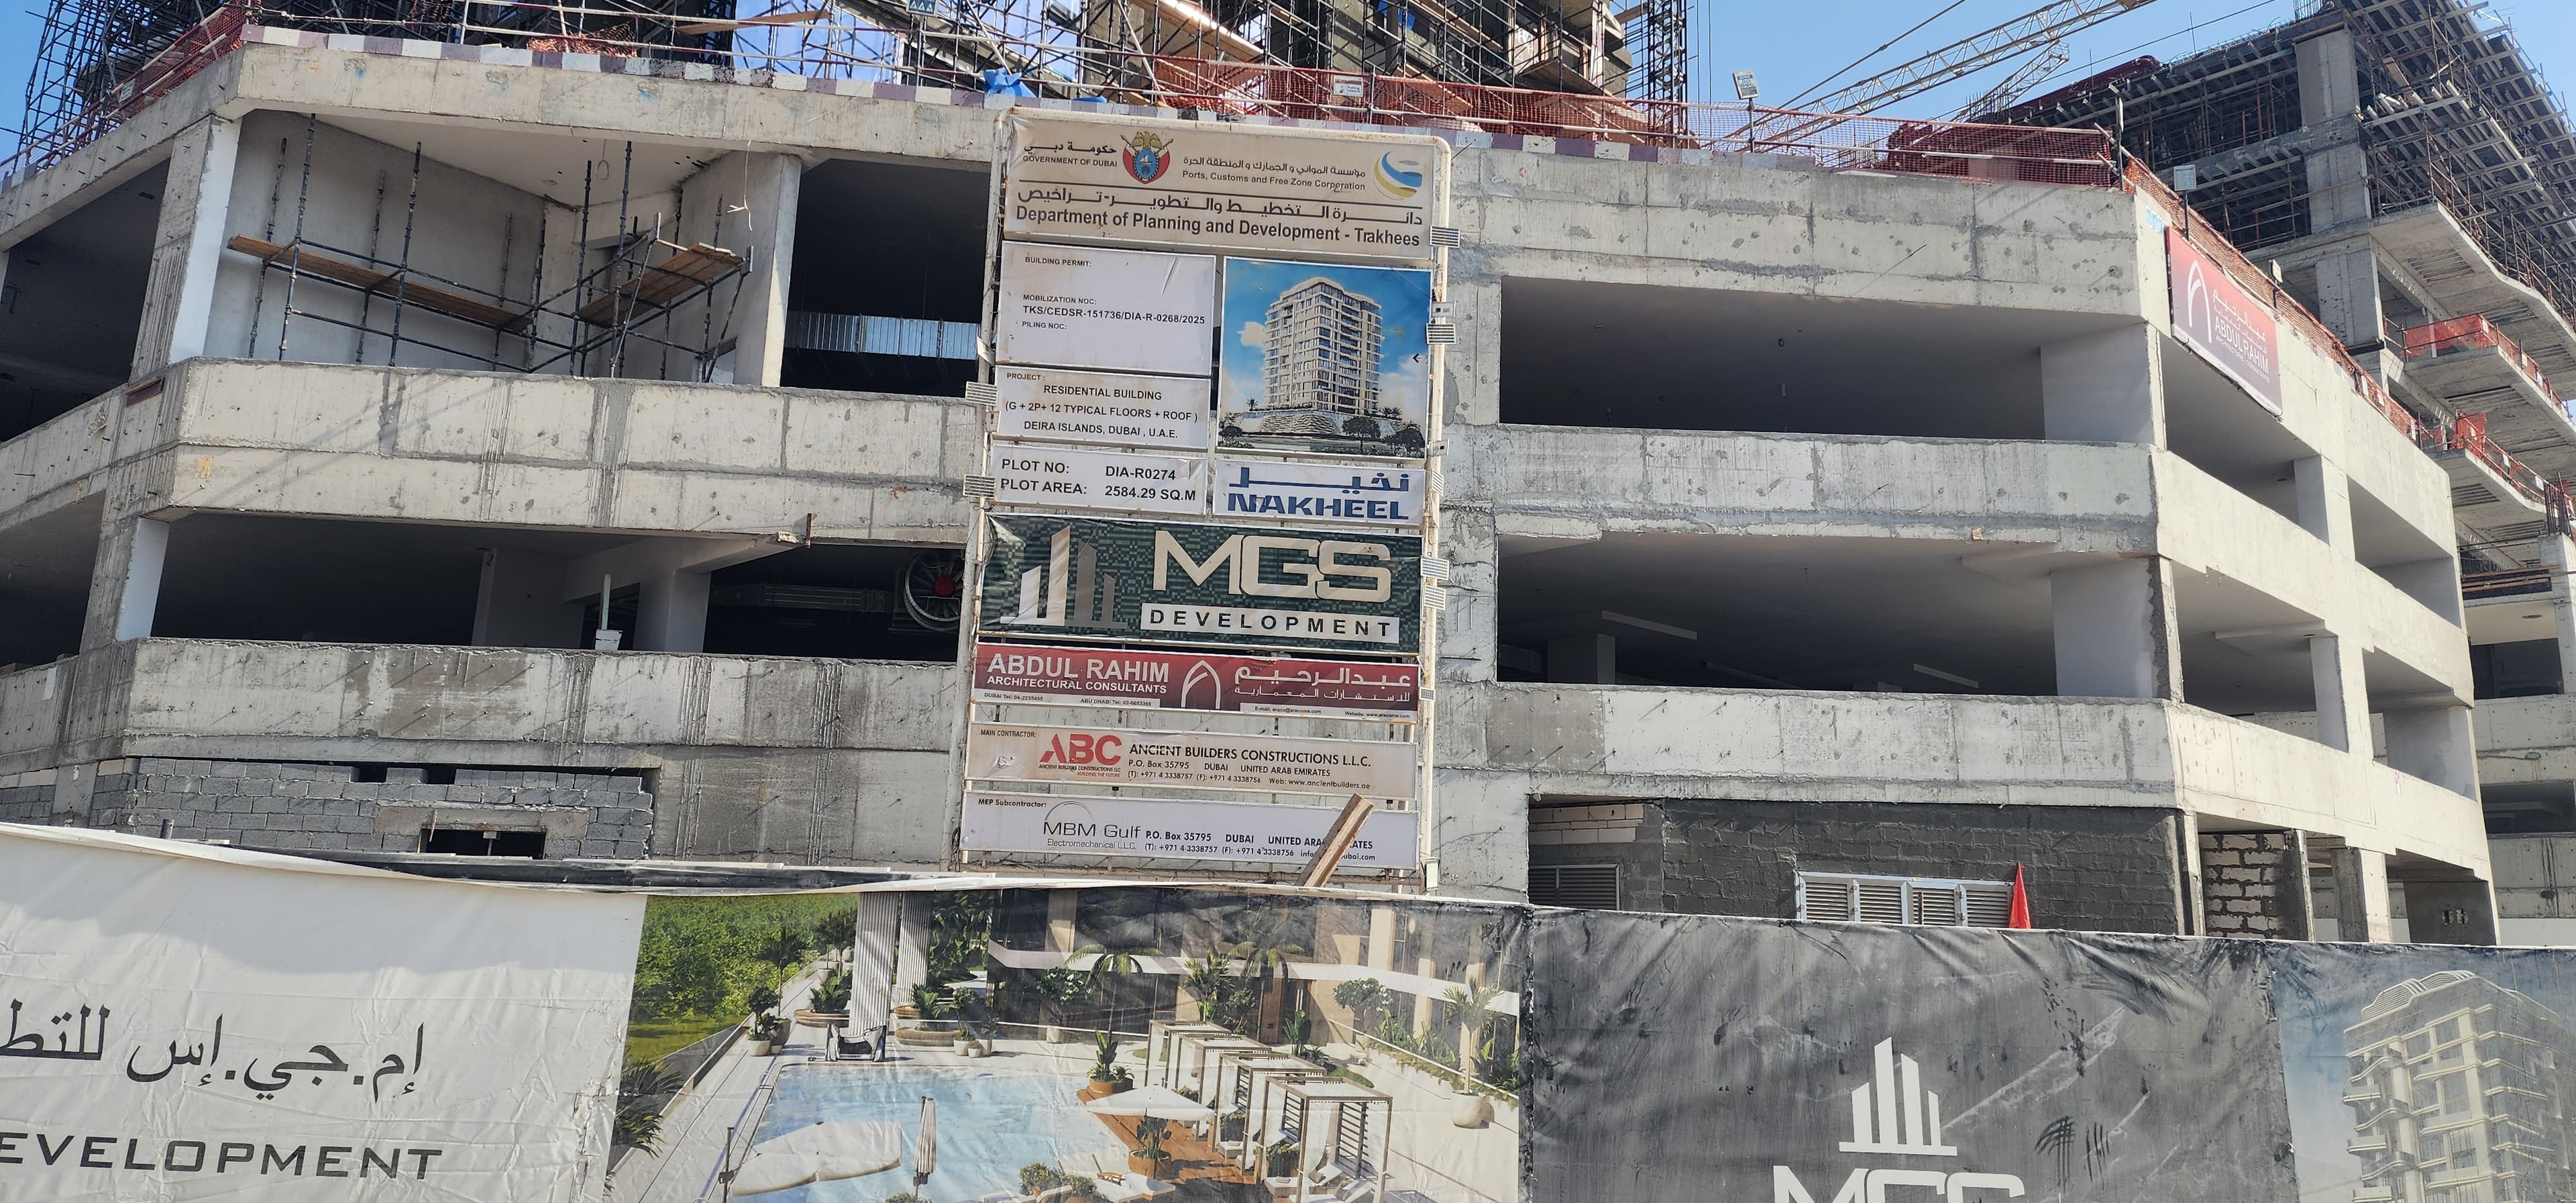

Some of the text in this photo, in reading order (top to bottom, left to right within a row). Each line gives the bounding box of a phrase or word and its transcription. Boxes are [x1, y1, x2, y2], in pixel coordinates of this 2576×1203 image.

[1024, 141, 1117, 156] حكومة دبي
[1022, 155, 1118, 167] GOVERNMENT OF DUBAI
[1183, 156, 1205, 166] الحرة
[1206, 157, 1244, 168] المنطقة
[1252, 161, 1287, 172] الجمارك
[1330, 166, 1366, 178] مؤسسة
[1183, 170, 1366, 191] Ports, Customs and Free Zone Corporation
[1226, 199, 1330, 219] التخطيط
[1016, 205, 1108, 225] Department
[1112, 212, 1129, 227] of
[1132, 213, 1201, 235] Planning
[1205, 219, 1234, 234] and
[1239, 220, 1340, 242] Development
[1354, 227, 1420, 246] Trakhees
[1025, 256, 1092, 267] BUILDING PERMIT:
[1023, 294, 1097, 305] MOBILIZATION NOC:
[1022, 305, 1205, 325] TKS/CEDSR-151736/DIA-R-0268/2025
[1022, 321, 1067, 330] PILING NOC:
[2215, 315, 2243, 353] ABDUL
[2243, 339, 2269, 375] RAHIM
[1006, 372, 1041, 381] PROJECT
[1043, 384, 1162, 401] RESIDENTIAL BUILDING
[1005, 401, 1017, 411] (G
[1051, 404, 1061, 413] 12
[1064, 405, 1107, 416] TYPICAL
[1109, 407, 1151, 419] FLOORS
[1163, 411, 1192, 421] ROOF
[1024, 421, 1056, 431] DEIRA
[1058, 423, 1106, 435] ISLANDS,
[1108, 425, 1141, 436] DUBAI
[1148, 428, 1179, 439] U.A.E.
[1002, 458, 1070, 474] PLOT NO:
[1106, 466, 1176, 481] DIA-R0274
[1000, 478, 1087, 494] PLOT AREA:
[1104, 485, 1197, 502] 2584.29 SQ.M
[1227, 492, 1409, 520] NAKHEEL
[1152, 529, 1392, 603] MGS
[1150, 609, 1392, 638] DEVELOPMENT
[987, 653, 1170, 683] ABDUL RAHIM
[986, 676, 1167, 694] ARCHITECTURAL CONSULTANTS
[997, 730, 1037, 738] CONTRACTOR:
[1039, 733, 1122, 766] ABC
[1129, 743, 1371, 767] ANCIENT BUILDERS CONSTRUCTIONS L.L.C.
[1128, 760, 1331, 776] P.O. Box 35795 DUBAI UNITED ARAB EMIRATES
[1128, 770, 1138, 779] (T):
[1196, 774, 1208, 782] (F):
[1233, 776, 1261, 784] 3338756
[1288, 779, 1371, 790] www.ancientbuilders.ae
[996, 798, 1046, 808] Subcontractor:
[1043, 821, 1141, 839] MBM Gulf
[1047, 838, 1116, 849] Electromechanical
[1145, 831, 1162, 840] P.O.
[1165, 831, 1181, 841] Box
[1183, 833, 1212, 842] 35795
[1226, 834, 1254, 843] DUBAI
[1268, 835, 1301, 846] UNITED
[1303, 837, 1324, 847] ARA
[1144, 843, 1157, 851] (T):
[1187, 845, 1218, 853] 3338757
[1222, 846, 1234, 855] (F):
[1263, 848, 1294, 857] 3338756
[0, 1131, 443, 1180] EVELOPMENT
